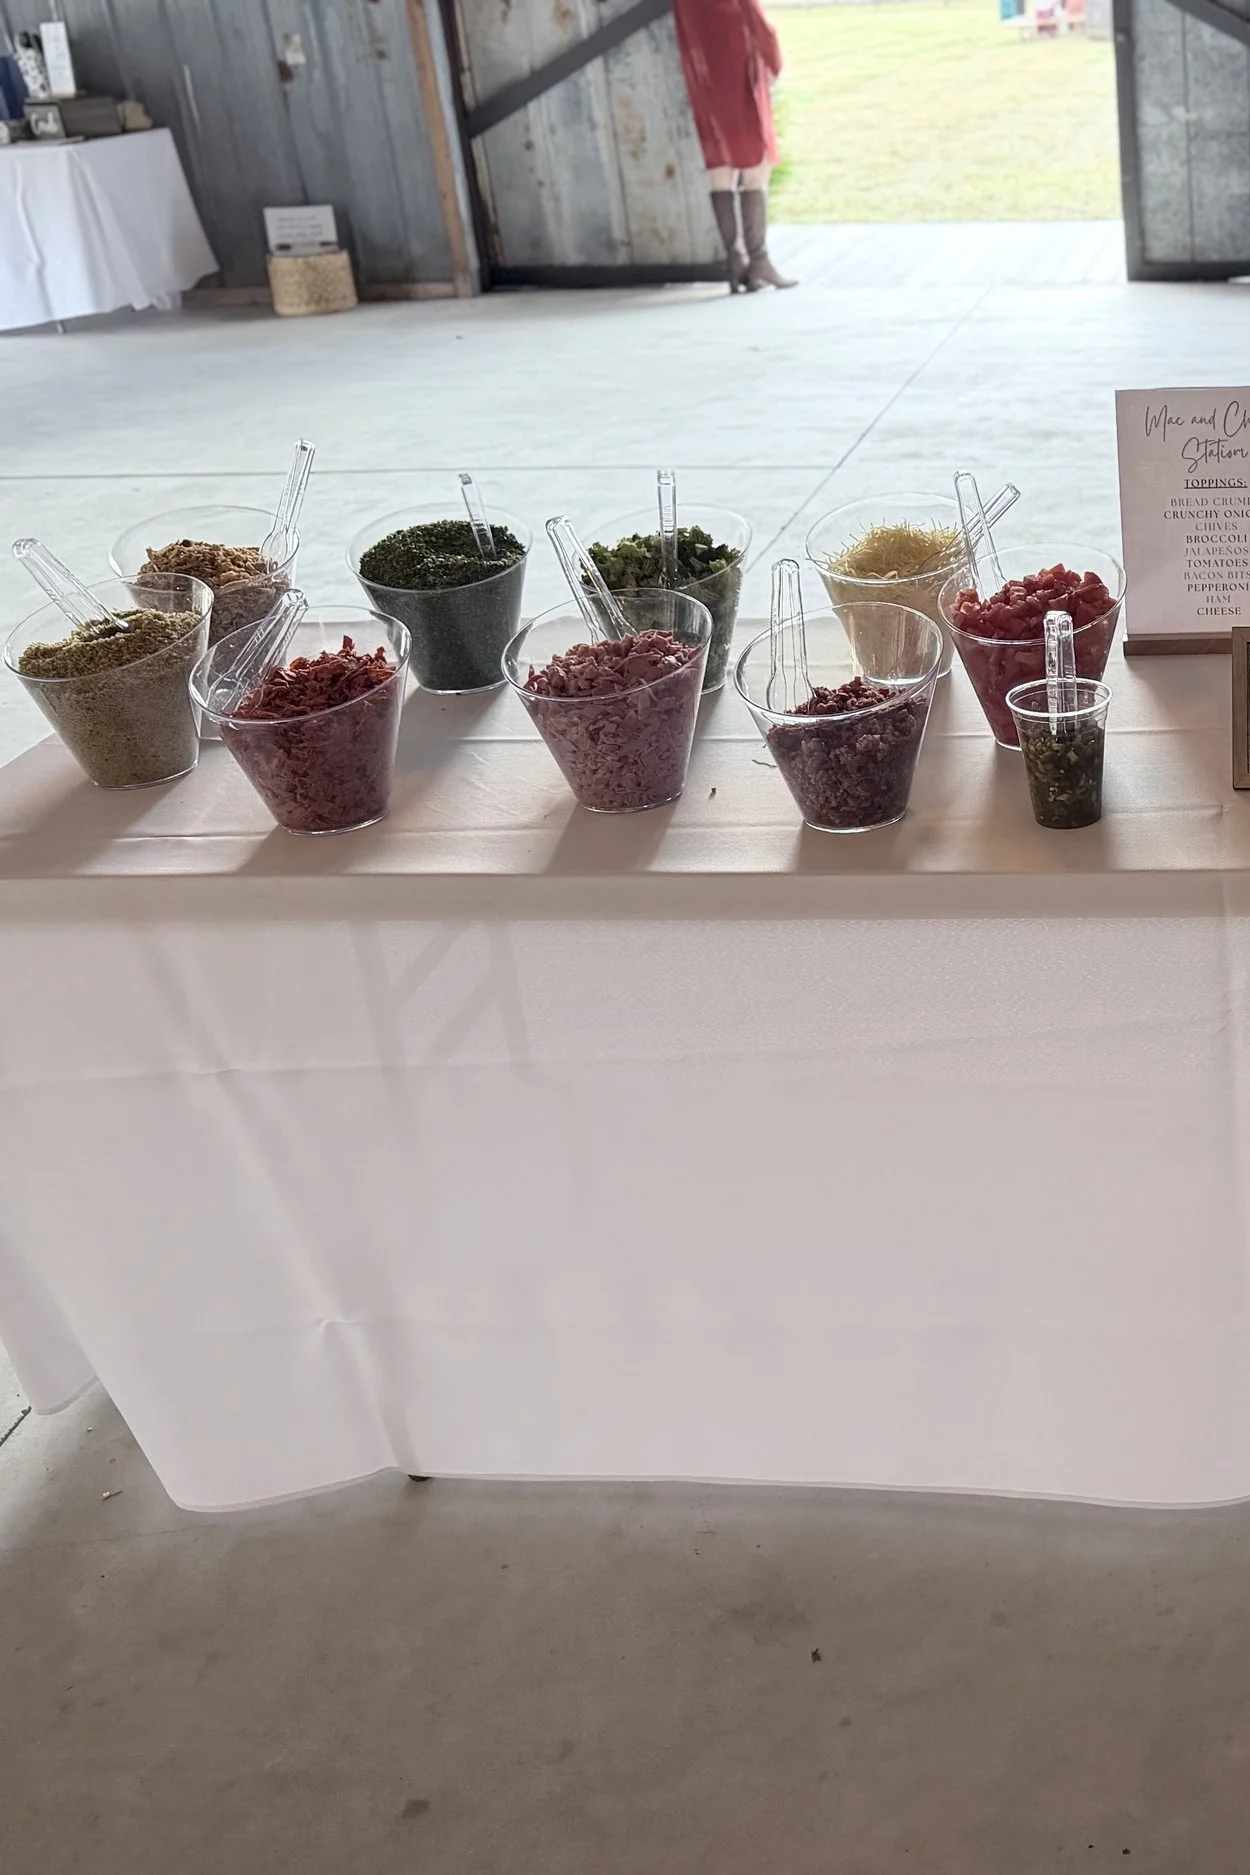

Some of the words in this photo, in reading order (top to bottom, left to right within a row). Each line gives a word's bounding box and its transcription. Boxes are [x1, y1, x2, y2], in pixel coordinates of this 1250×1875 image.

[1145, 404, 1185, 442] Mac
[1191, 408, 1217, 430] and
[1181, 436, 1249, 474] Station
[1184, 478, 1249, 490] TOPPINGS:
[1170, 497, 1209, 507] BREAD
[1163, 509, 1220, 520] CRUNCHY
[1195, 522, 1238, 532] CHIVES
[1186, 533, 1248, 544] BROCCOLI
[1184, 545, 1249, 557] JALAPEÑOS
[1186, 558, 1249, 569] TOMATOES
[1183, 571, 1224, 581] BACON
[1187, 582, 1249, 592] PEPPERONI
[1206, 594, 1231, 604] HAM
[1196, 606, 1242, 616] CHEESE
